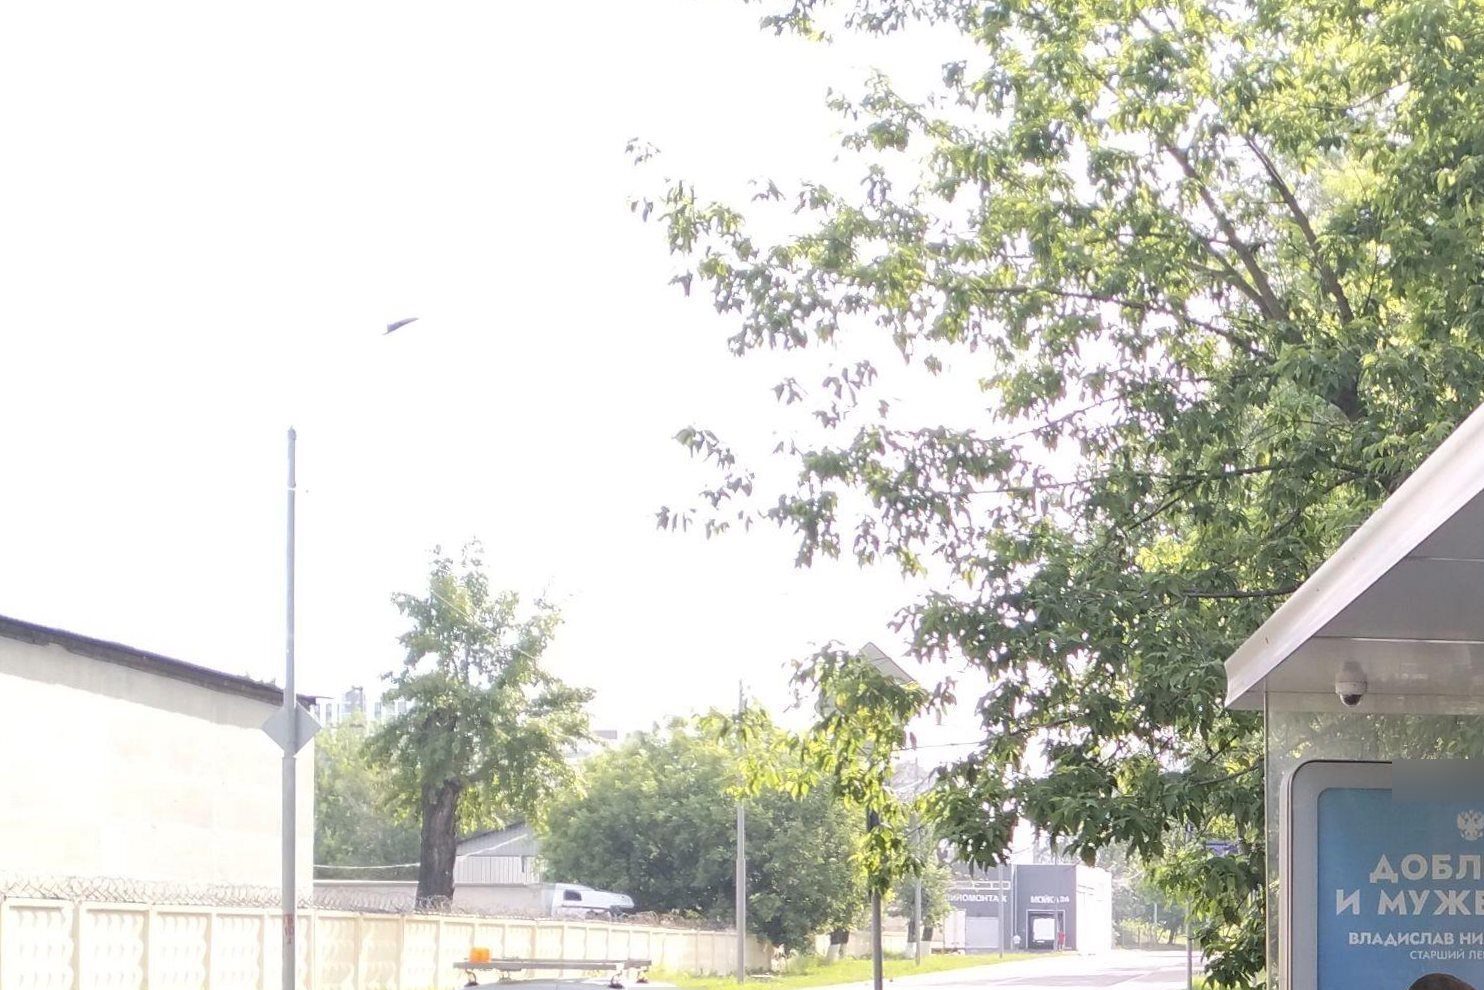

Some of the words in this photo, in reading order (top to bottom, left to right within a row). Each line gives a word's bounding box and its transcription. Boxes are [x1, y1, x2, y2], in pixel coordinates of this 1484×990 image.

[1335, 888, 1361, 916] И
[1348, 932, 1455, 947] ВЛАДИСЛАВ
[1409, 949, 1465, 960] СТАРШИЙ
